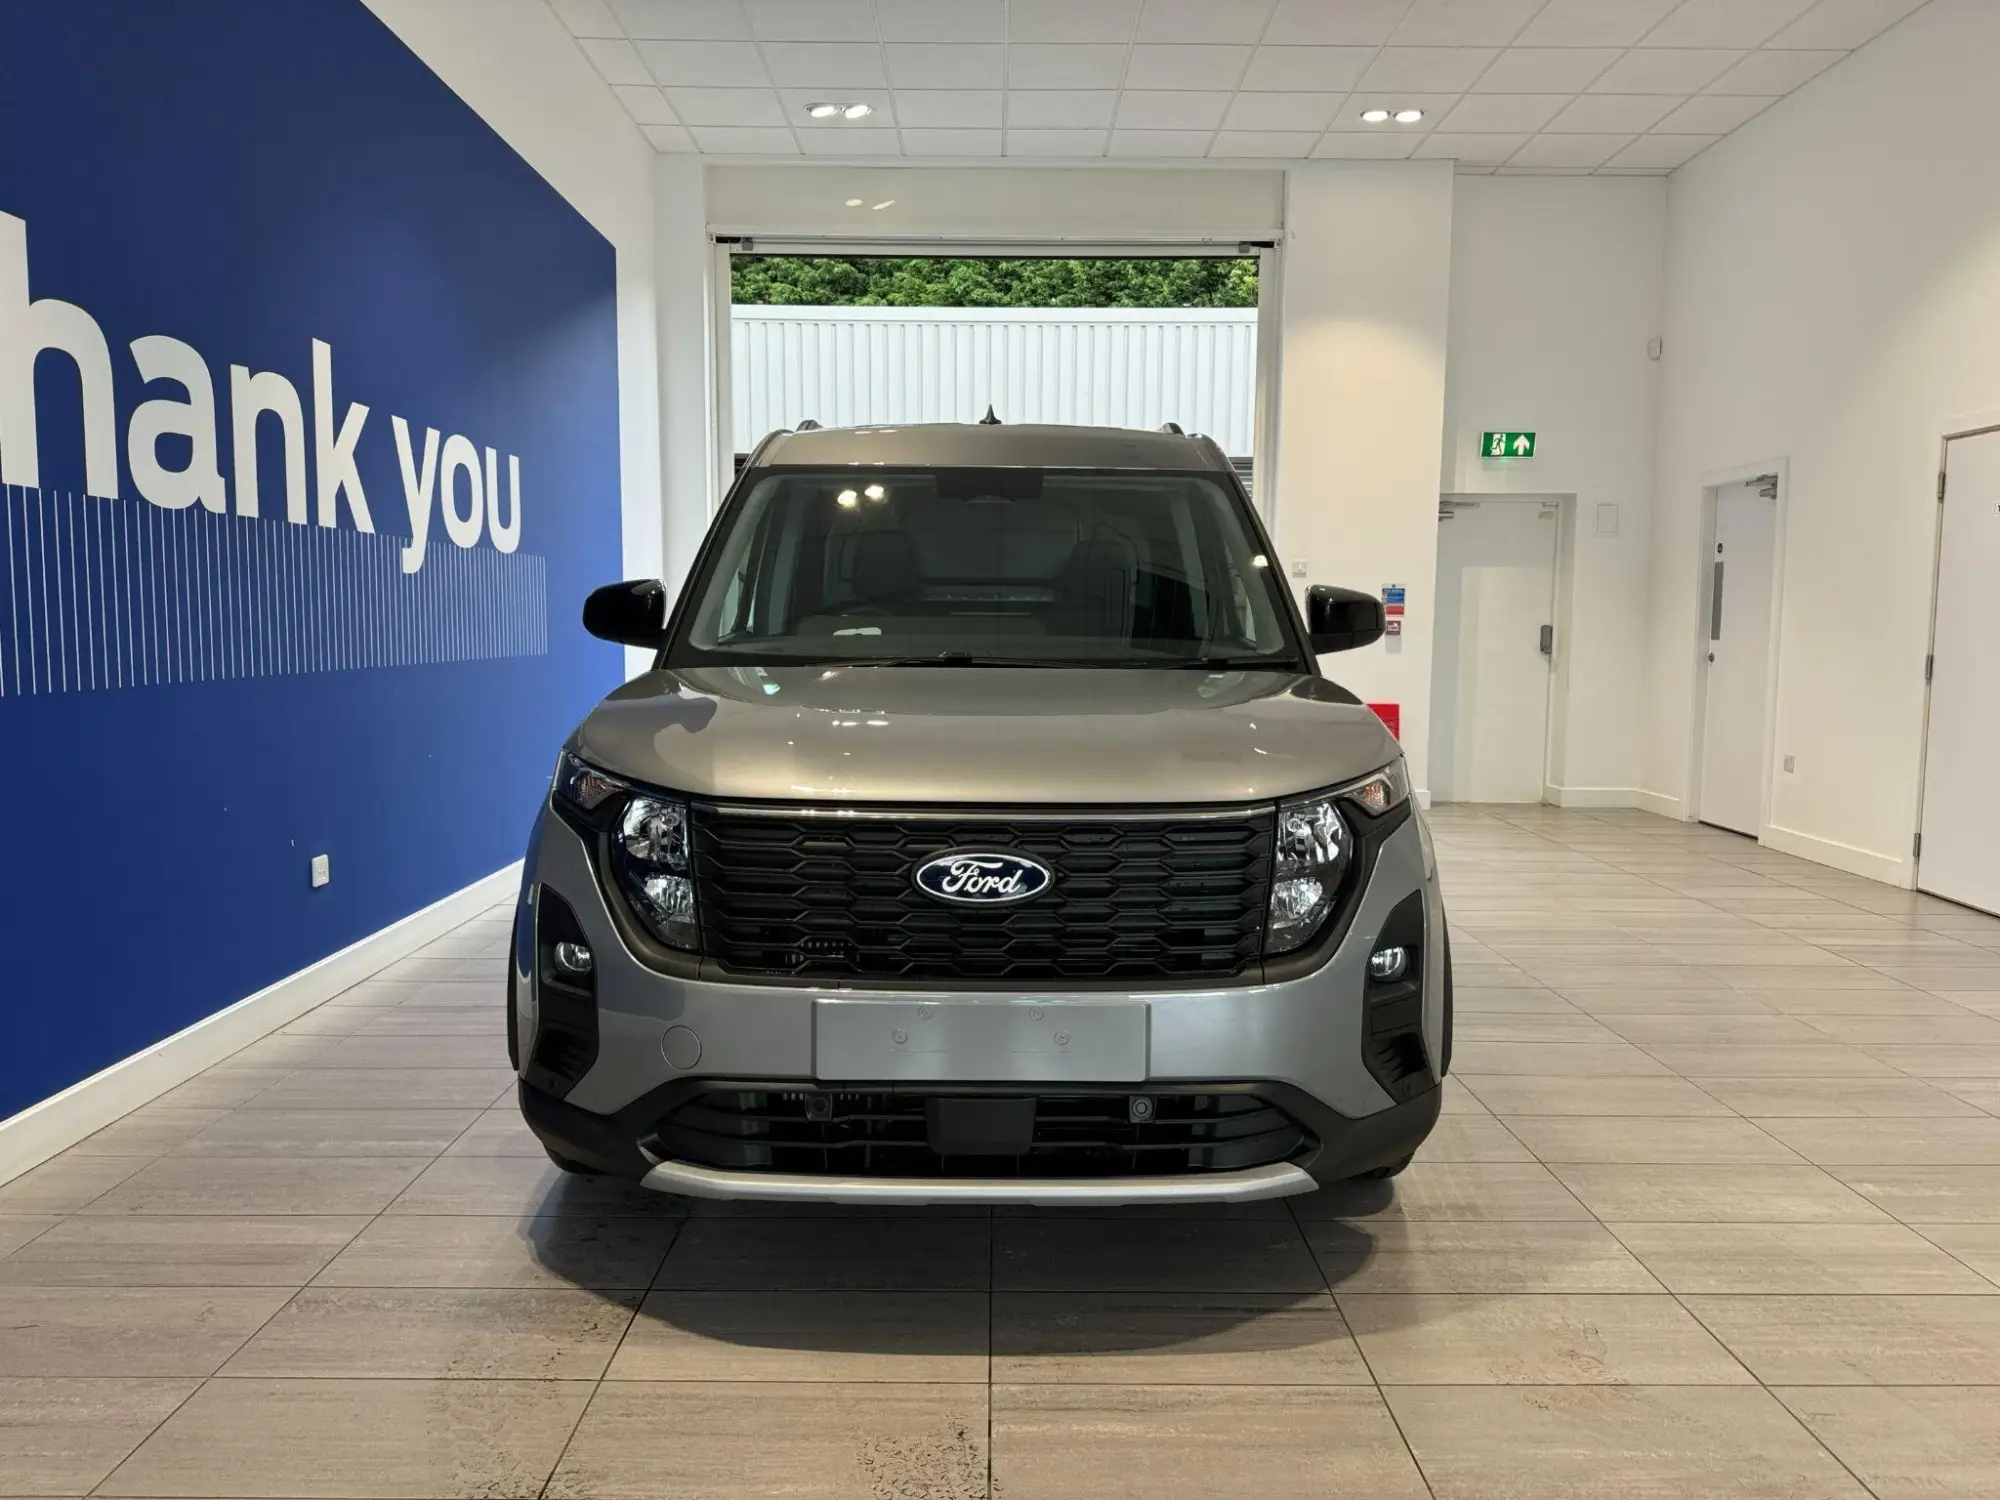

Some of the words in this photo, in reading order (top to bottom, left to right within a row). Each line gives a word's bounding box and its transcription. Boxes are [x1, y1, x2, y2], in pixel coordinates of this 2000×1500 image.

[0, 211, 375, 534] hank
[391, 415, 521, 574] you
[941, 859, 1024, 894] Ford
